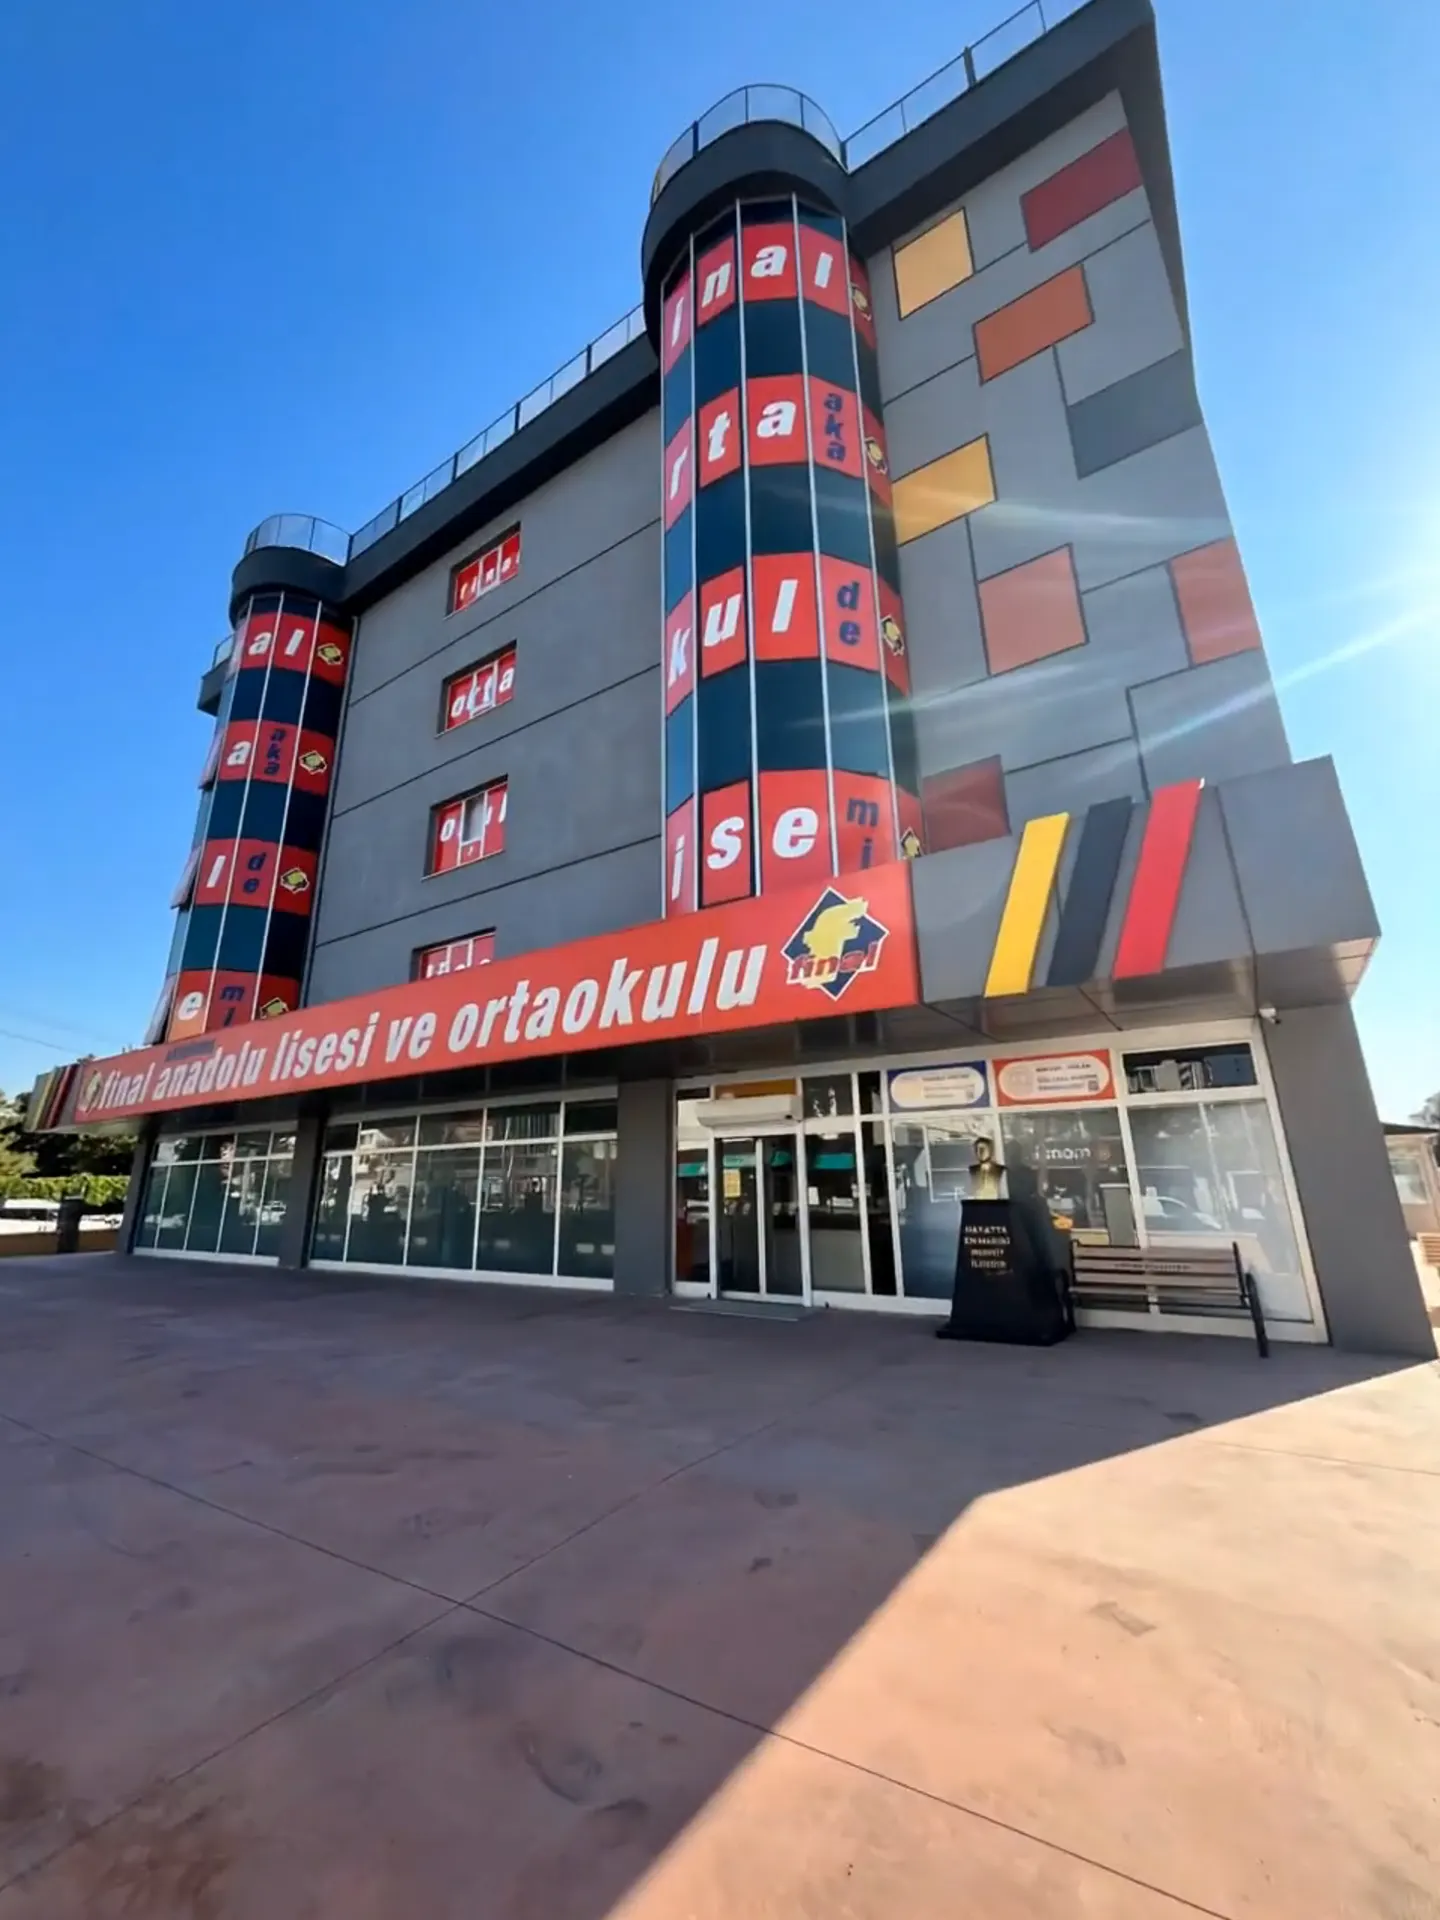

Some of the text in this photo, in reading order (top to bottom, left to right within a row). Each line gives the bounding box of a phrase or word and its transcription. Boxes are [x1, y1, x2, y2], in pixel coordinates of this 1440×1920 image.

[667, 579, 798, 688] kul
[837, 581, 861, 646] de
[98, 937, 768, 1111] final anadolu lisesi ve ortaokulu
